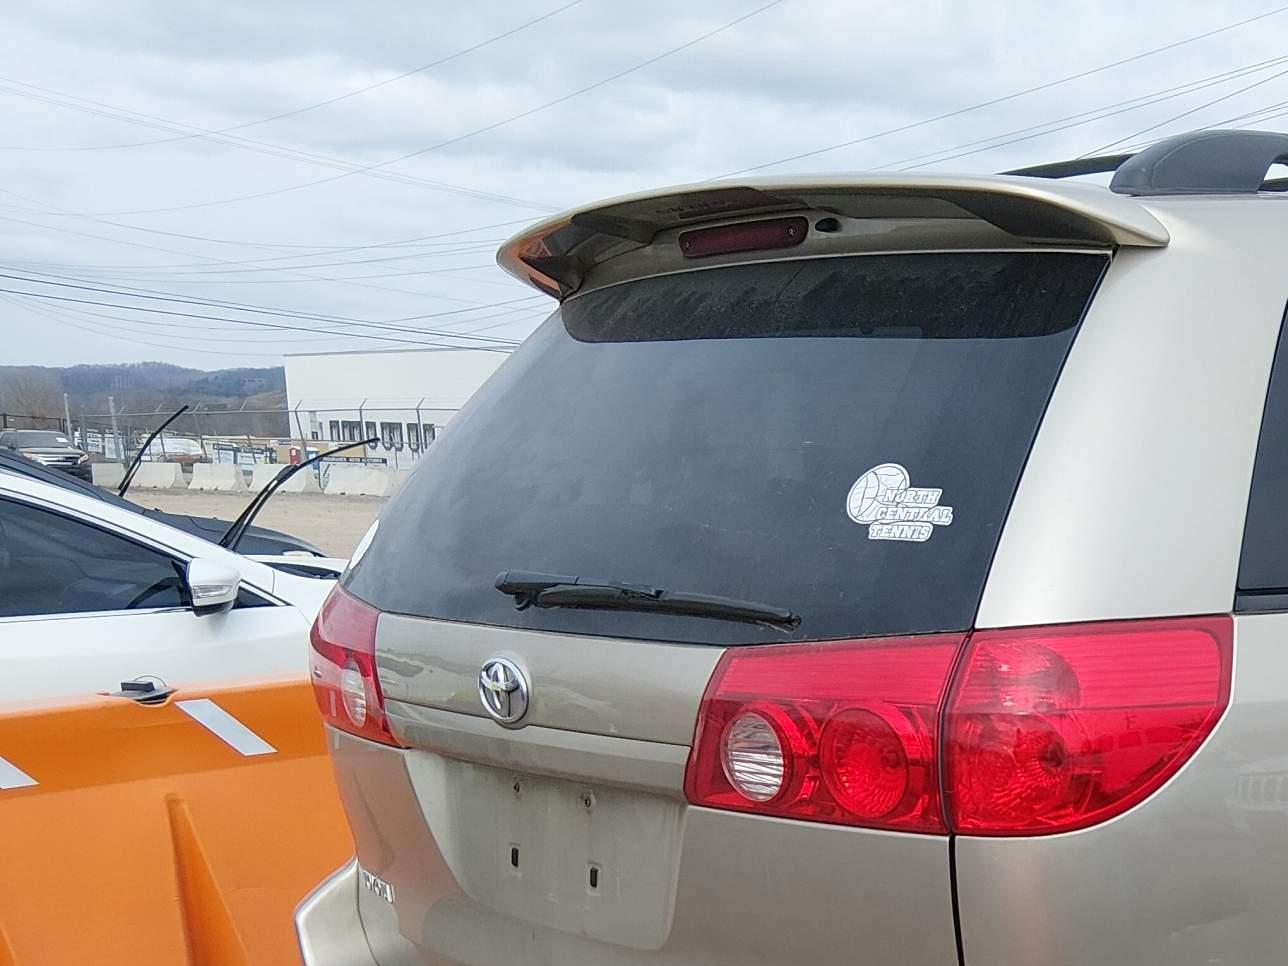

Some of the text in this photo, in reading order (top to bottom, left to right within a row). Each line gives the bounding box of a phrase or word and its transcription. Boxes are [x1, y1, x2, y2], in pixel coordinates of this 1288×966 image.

[882, 489, 939, 504] NORTH
[876, 506, 952, 523] CENTRAL
[871, 524, 930, 539] TENNIS
